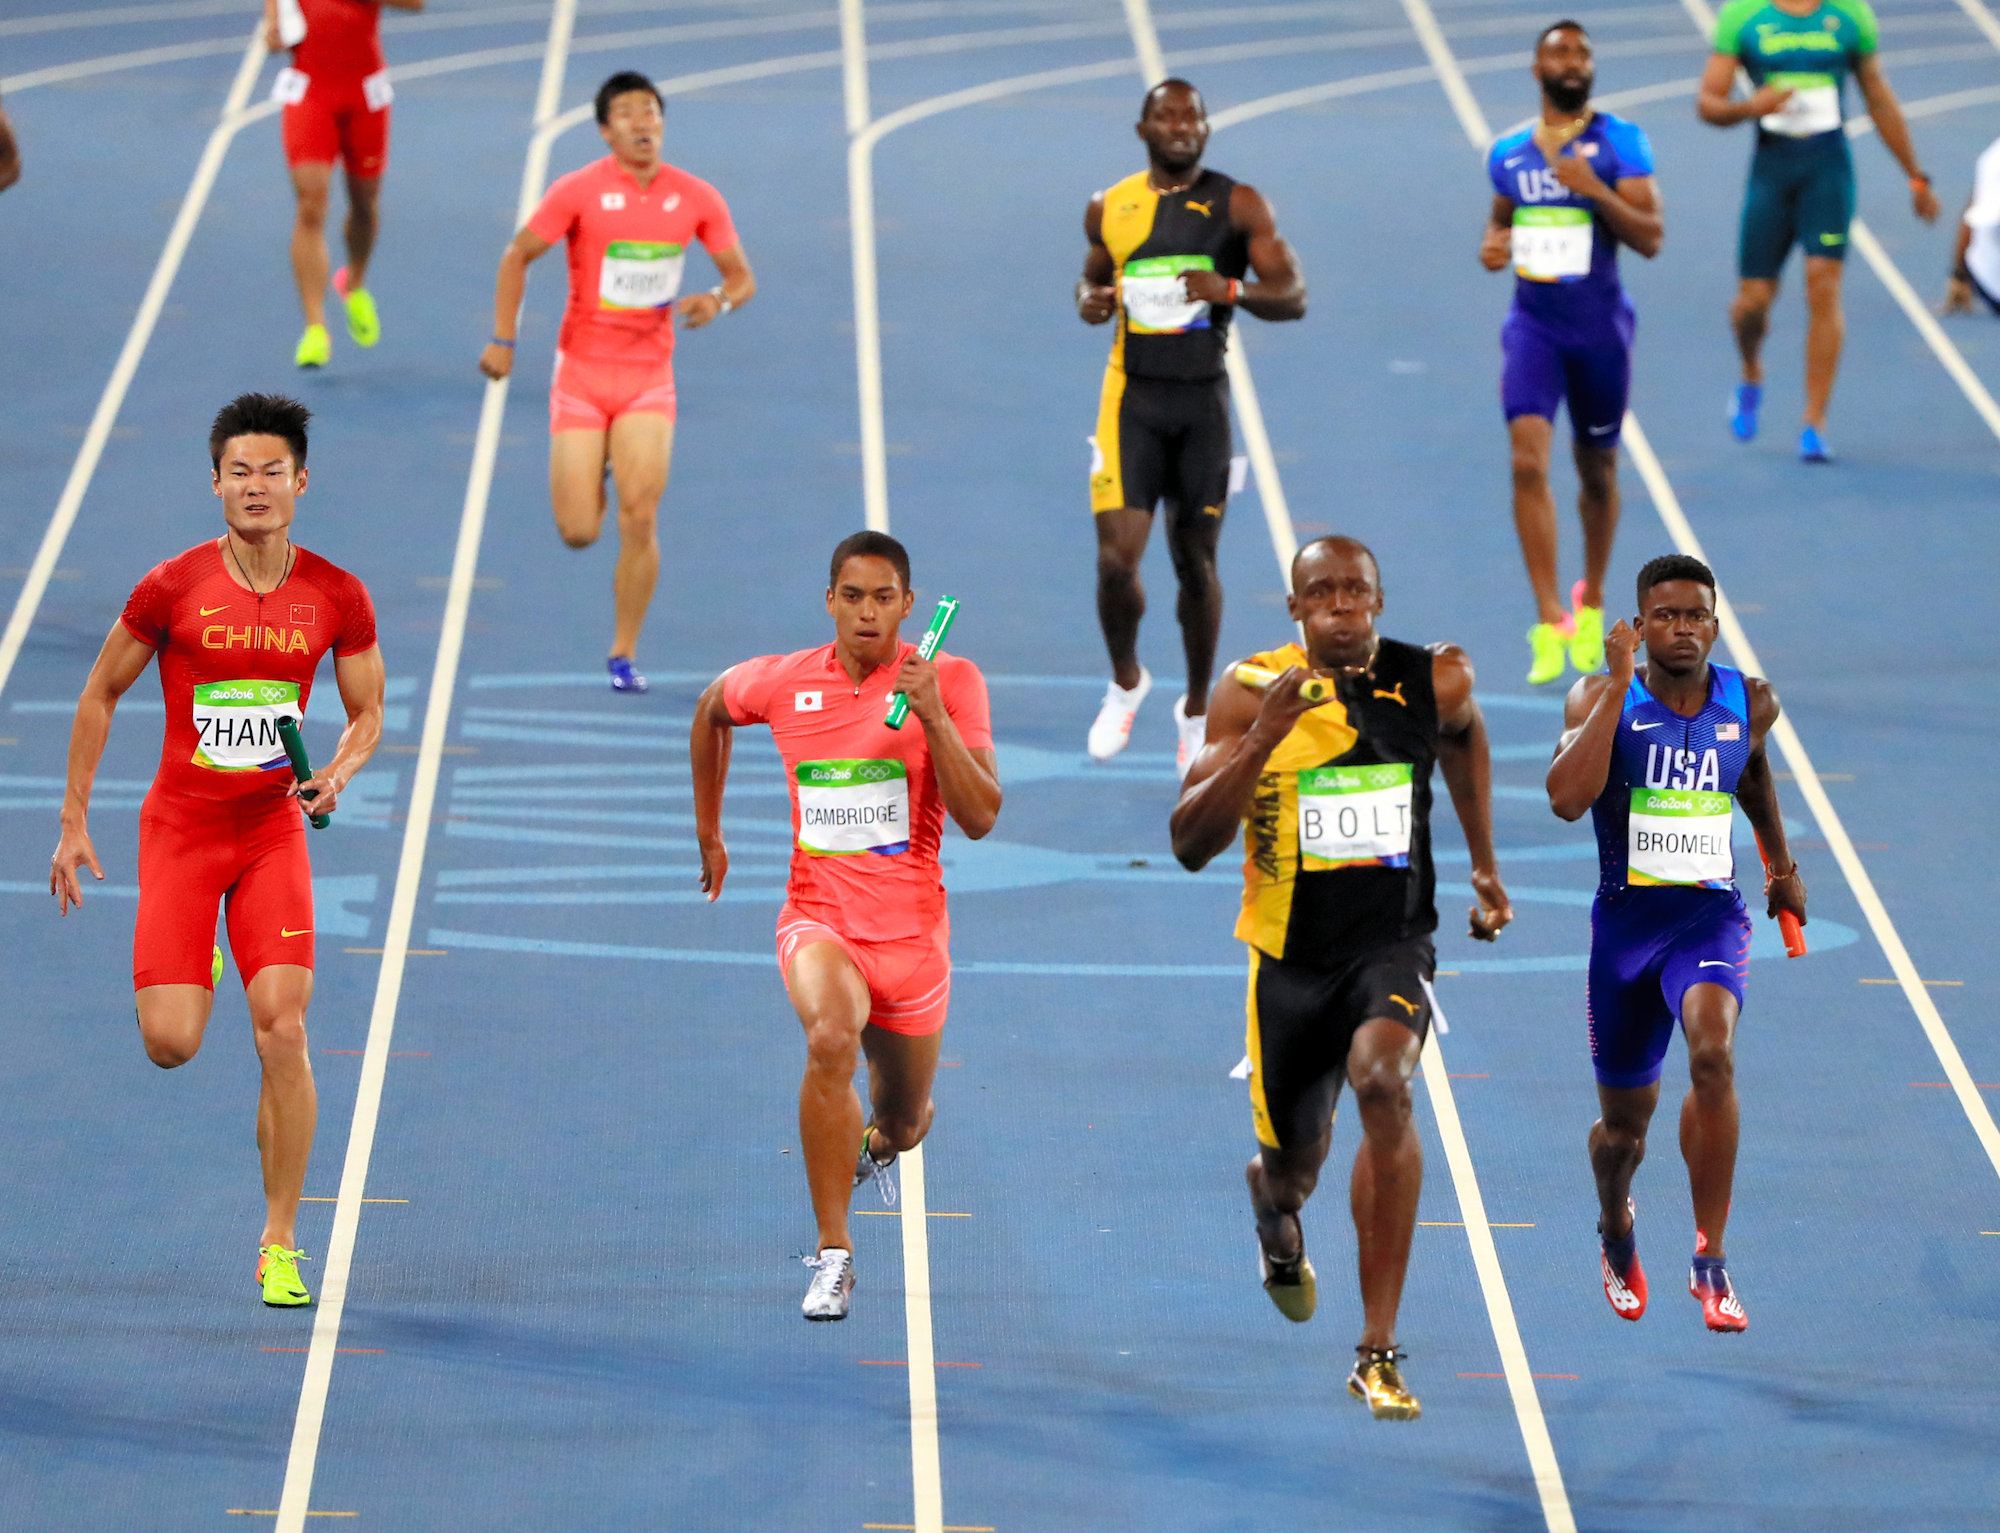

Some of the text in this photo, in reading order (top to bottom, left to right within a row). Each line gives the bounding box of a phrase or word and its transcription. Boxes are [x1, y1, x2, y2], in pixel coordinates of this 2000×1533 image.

[1517, 167, 1570, 203] US
[201, 625, 310, 655] CHINA
[196, 718, 278, 746] ZHAN
[811, 768, 852, 780] Rio2016
[1645, 743, 1720, 791] USA
[805, 804, 898, 825] CAMBRIDGE
[1647, 795, 1693, 810] Rio2016
[1304, 804, 1409, 840] BOLT
[1637, 831, 1726, 855] BROMELL
